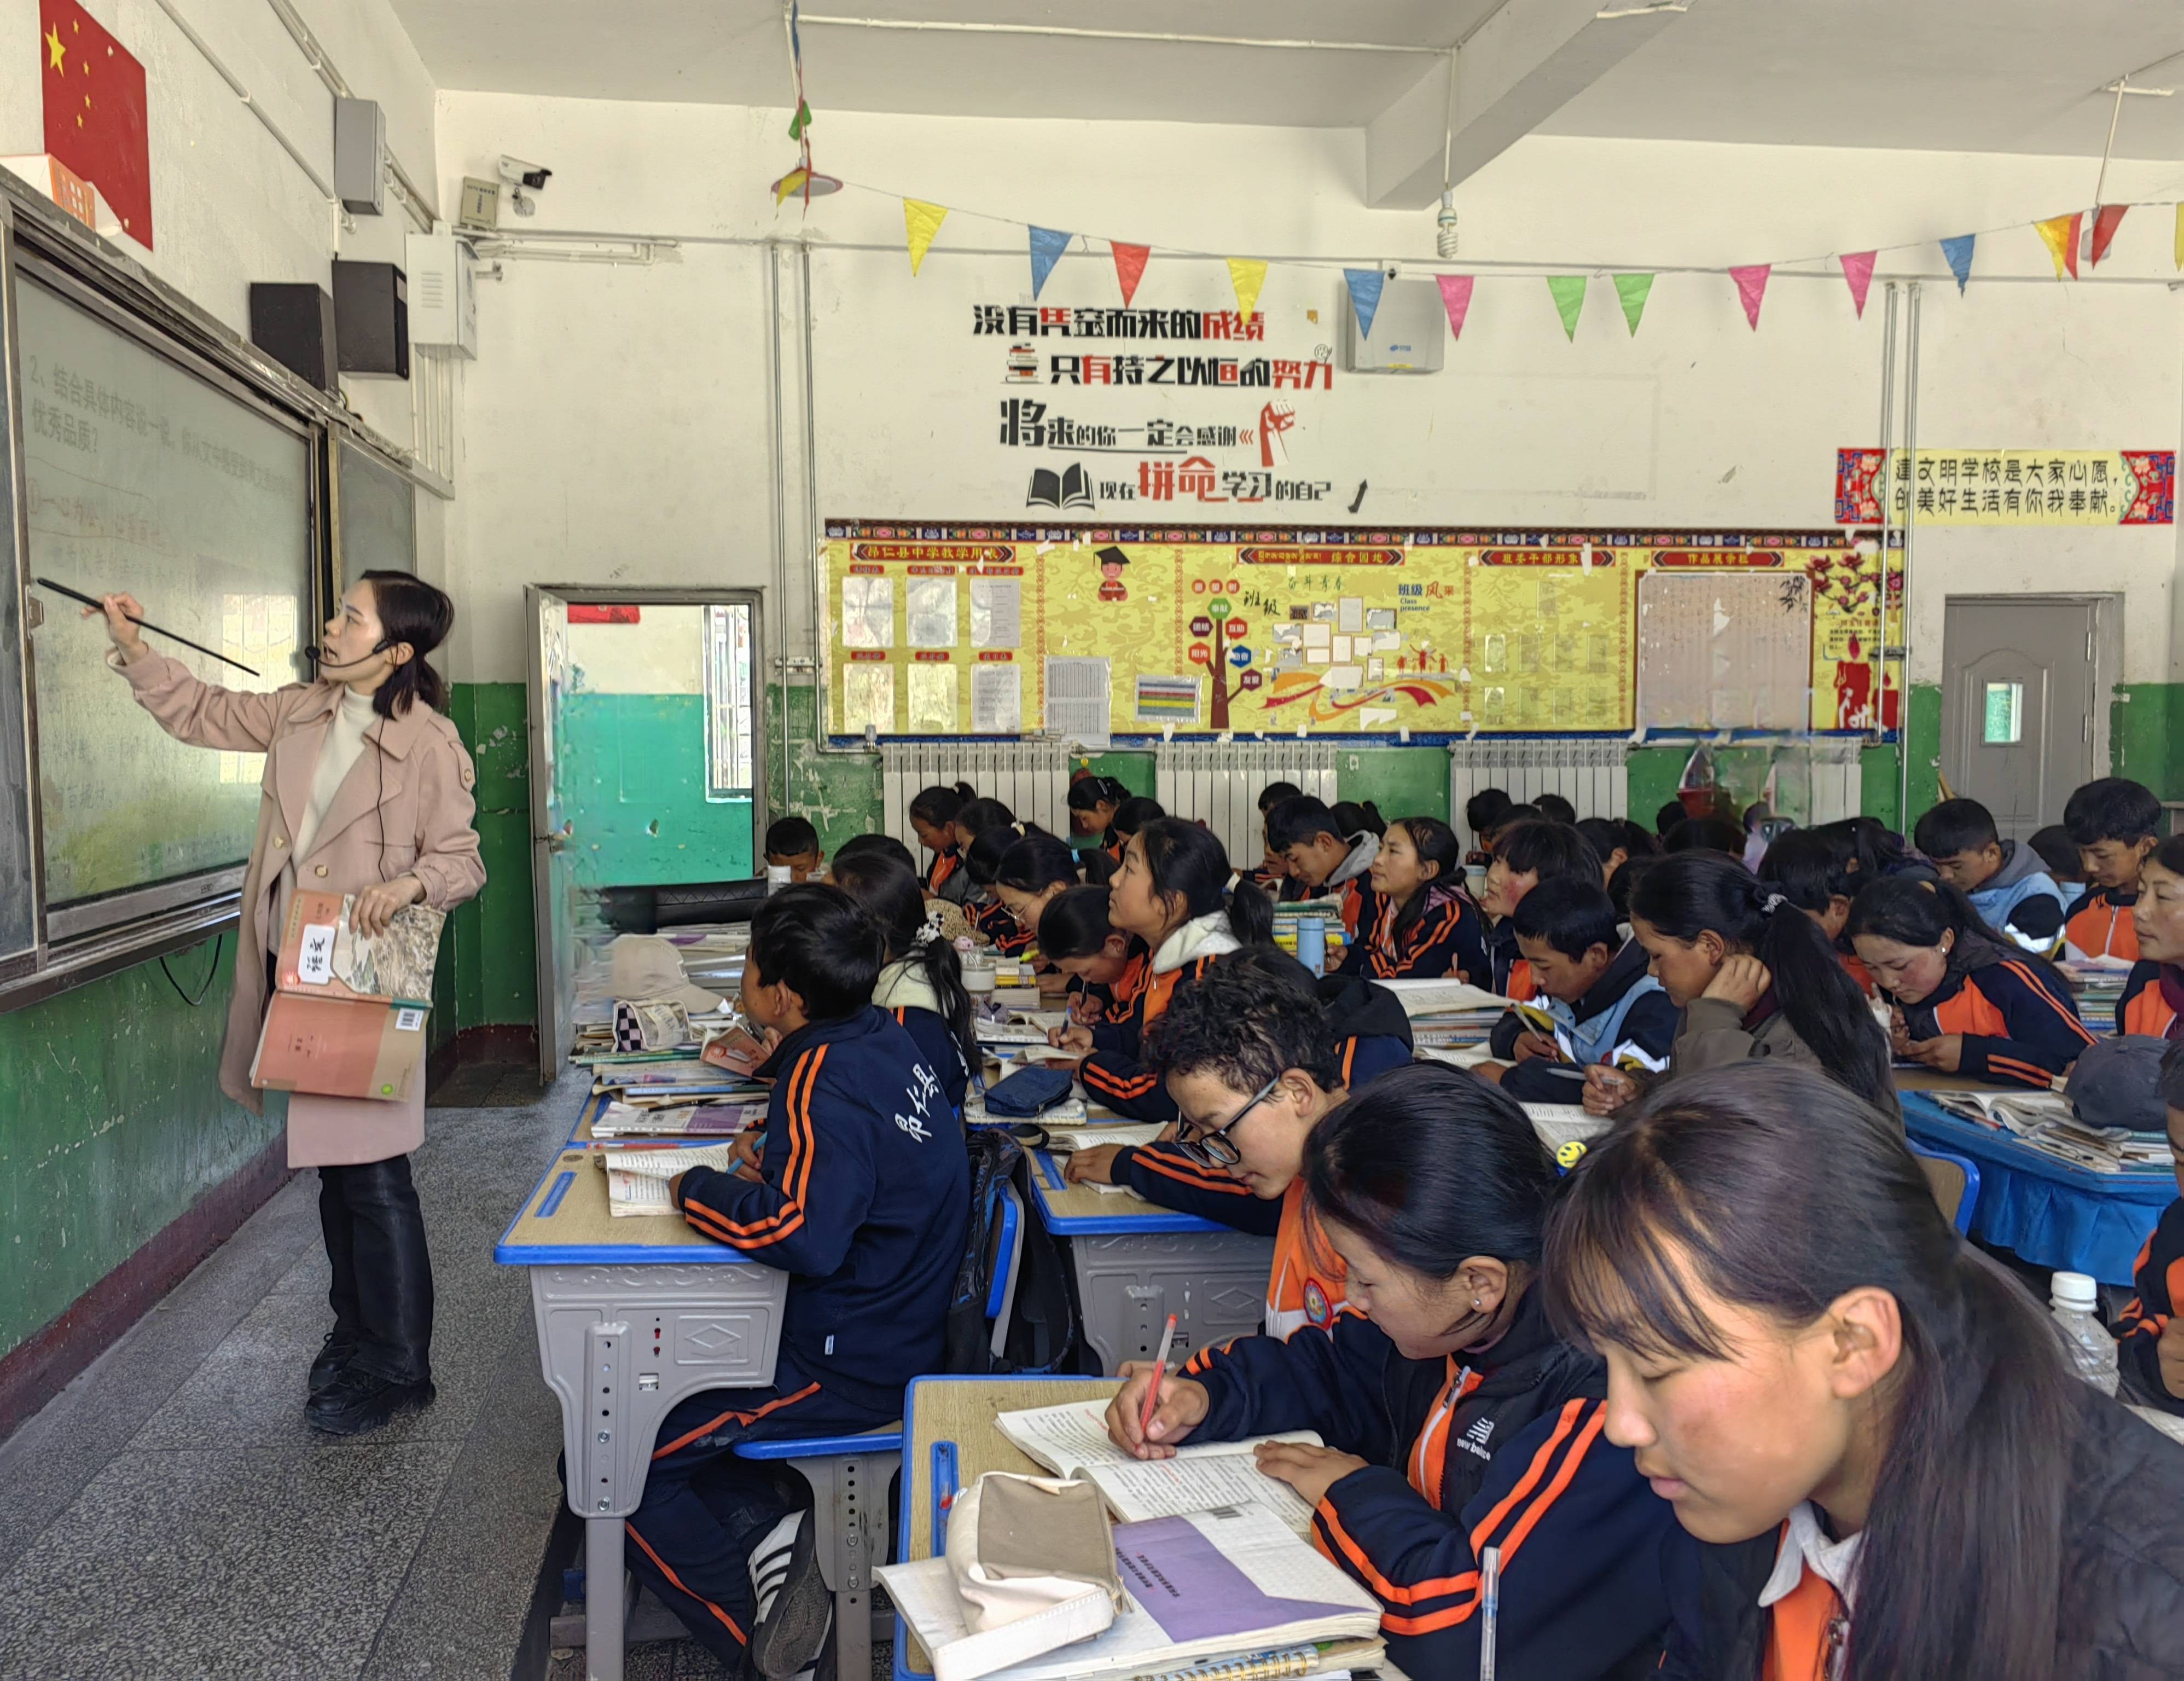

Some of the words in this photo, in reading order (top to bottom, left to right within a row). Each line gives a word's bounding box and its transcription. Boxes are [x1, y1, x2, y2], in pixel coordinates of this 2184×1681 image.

[973, 305, 1265, 341] 没有凭空而来的成绩
[1050, 355, 1332, 389] 只有持之以恒的努力
[1000, 398, 1236, 447] 将来的你一定会感谢
[1099, 456, 1332, 502] 现在拼命学习的自己
[1895, 457, 2118, 487] 建文明学校是大家心愿，
[1895, 488, 2116, 517] 创美好生活有你我奉献。
[1331, 551, 1384, 564] 综合园地
[1502, 553, 1578, 565] 班委干部形象
[1687, 553, 1750, 565] 作品展示栏
[1244, 590, 1281, 616] 班级
[1398, 581, 1454, 599] 班级风采
[1457, 1437, 1471, 1450] new
